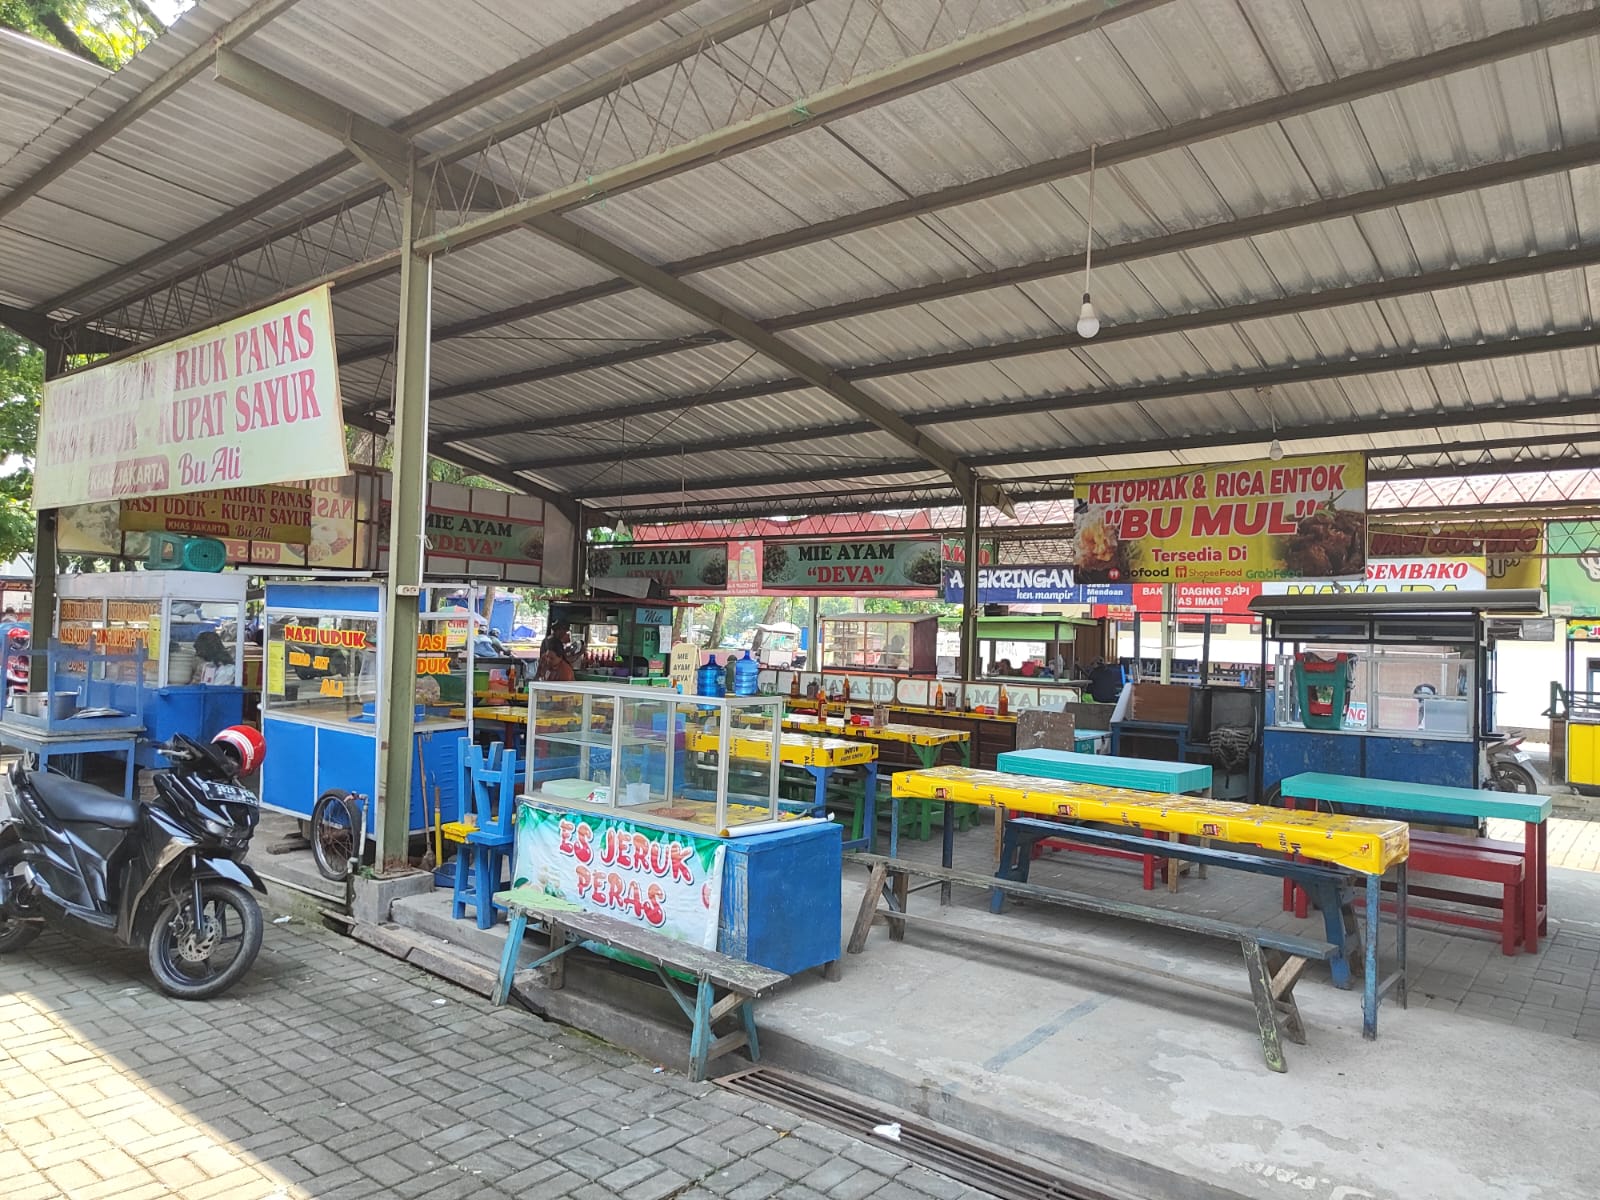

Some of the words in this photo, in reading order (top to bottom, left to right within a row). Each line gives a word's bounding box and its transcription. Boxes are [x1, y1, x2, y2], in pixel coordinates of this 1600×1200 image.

[234, 308, 314, 377] PANAS
[159, 391, 228, 446] KUPAT
[235, 368, 322, 433] SAYUR
[115, 462, 165, 489] JAKARTA
[178, 452, 206, 486] Bu
[212, 446, 243, 482] Ali
[1088, 475, 1188, 504] KETOPRAK
[1192, 475, 1206, 498] &
[1215, 470, 1264, 497] RICA
[1270, 465, 1345, 494] ENTOK
[271, 490, 312, 509] PANAS
[164, 499, 205, 517] UDUK
[222, 503, 265, 524] KUPAT
[270, 507, 311, 527] SAYUR
[1105, 507, 1182, 540] "BU
[1191, 499, 1316, 536] MUL"
[168, 521, 190, 530] KHAS
[192, 523, 227, 534] JAKARTA
[235, 527, 251, 537] Bu
[255, 526, 272, 539] Ali
[460, 518, 512, 537] AYAM
[620, 551, 646, 565] MIE
[648, 550, 691, 565] AYAM
[799, 545, 833, 561] MIE
[836, 543, 895, 560] AYAM
[1152, 546, 1222, 562] Tersedia
[1228, 545, 1247, 561] Di
[950, 569, 1075, 588] AGKRINGAN
[1189, 568, 1242, 577] ShopeeFood
[1246, 568, 1303, 579] GrabFood
[1366, 562, 1468, 579] SEMBAKO
[1035, 590, 1073, 602] mampir
[1087, 588, 1123, 596] Mendoan
[1181, 587, 1222, 595] DAGING
[1225, 587, 1250, 595] SAPI
[645, 609, 663, 622] Mie
[285, 625, 317, 643] NASI
[319, 629, 366, 649] UDUK
[416, 657, 451, 675] DUK
[559, 818, 594, 865] ES
[600, 826, 694, 886] JERUK
[575, 865, 667, 928] PERAS
